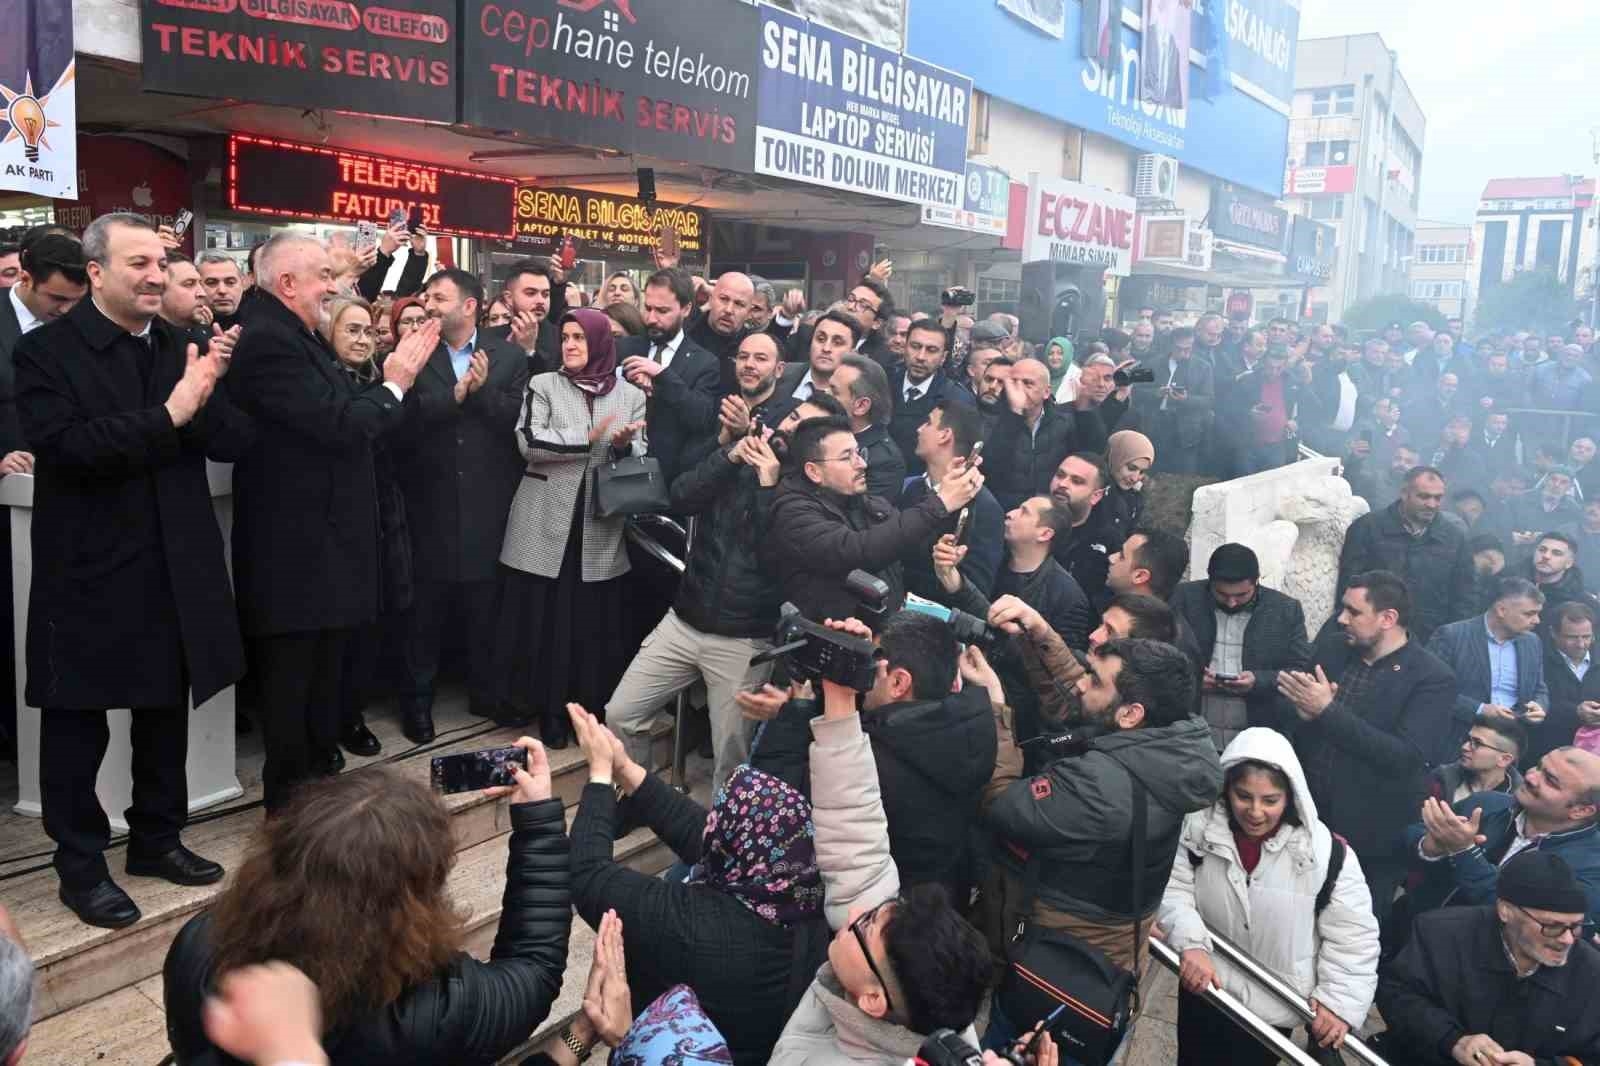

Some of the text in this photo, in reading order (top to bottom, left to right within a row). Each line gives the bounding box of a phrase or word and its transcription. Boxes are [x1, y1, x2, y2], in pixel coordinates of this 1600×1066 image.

[151, 23, 449, 87] TEKNİK SERVİS
[367, 13, 444, 39] TELEFON
[481, 4, 750, 98] cephane telekom
[490, 63, 736, 143] TEKNİK SERVİS
[763, 21, 965, 127] SENA BİLGİSAYAR
[802, 102, 936, 165] LAPTOP SERVİSİ
[5, 165, 25, 177] AK
[338, 158, 438, 194] TELEFON
[763, 136, 825, 180] TONER
[832, 152, 890, 192] DOLUM
[895, 164, 958, 206] MERKEZİ
[516, 222, 558, 235] LAPTOP
[602, 231, 614, 242] VE
[518, 190, 699, 237] SENA BİLGİSAYAR
[1038, 188, 1132, 249] ECZANE
